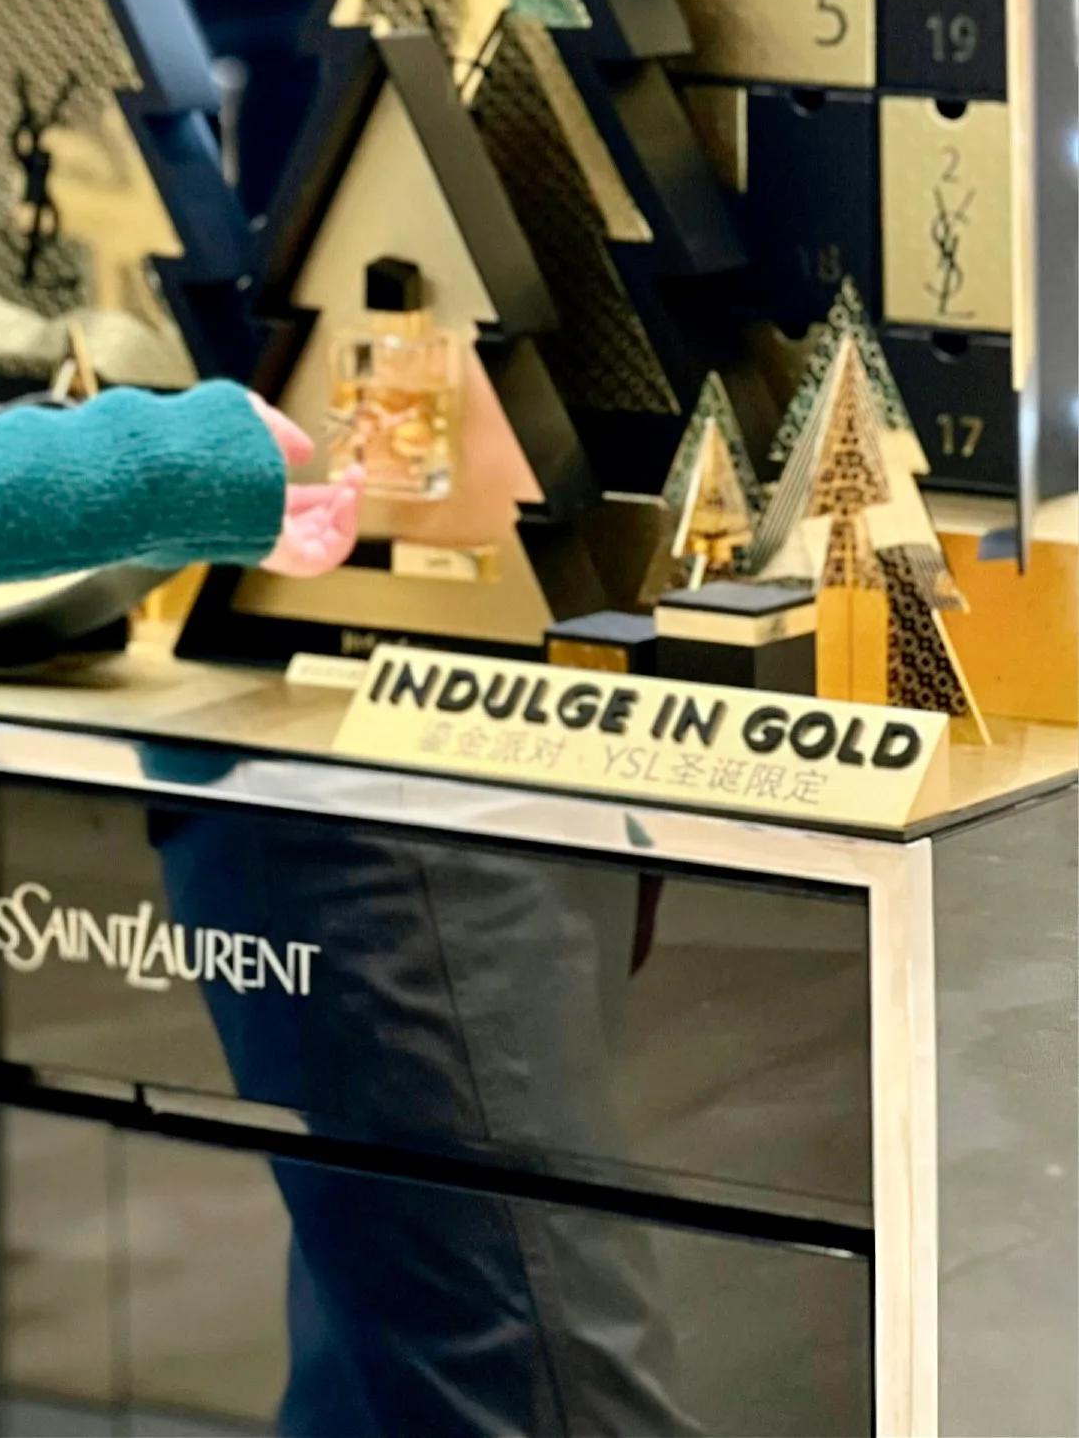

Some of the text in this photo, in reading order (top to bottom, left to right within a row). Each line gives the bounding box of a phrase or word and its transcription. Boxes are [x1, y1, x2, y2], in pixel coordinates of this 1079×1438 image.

[926, 14, 977, 62] 19
[940, 145, 961, 183] 2
[936, 413, 984, 458] 17
[368, 659, 922, 772] INDULGE IN GOLD
